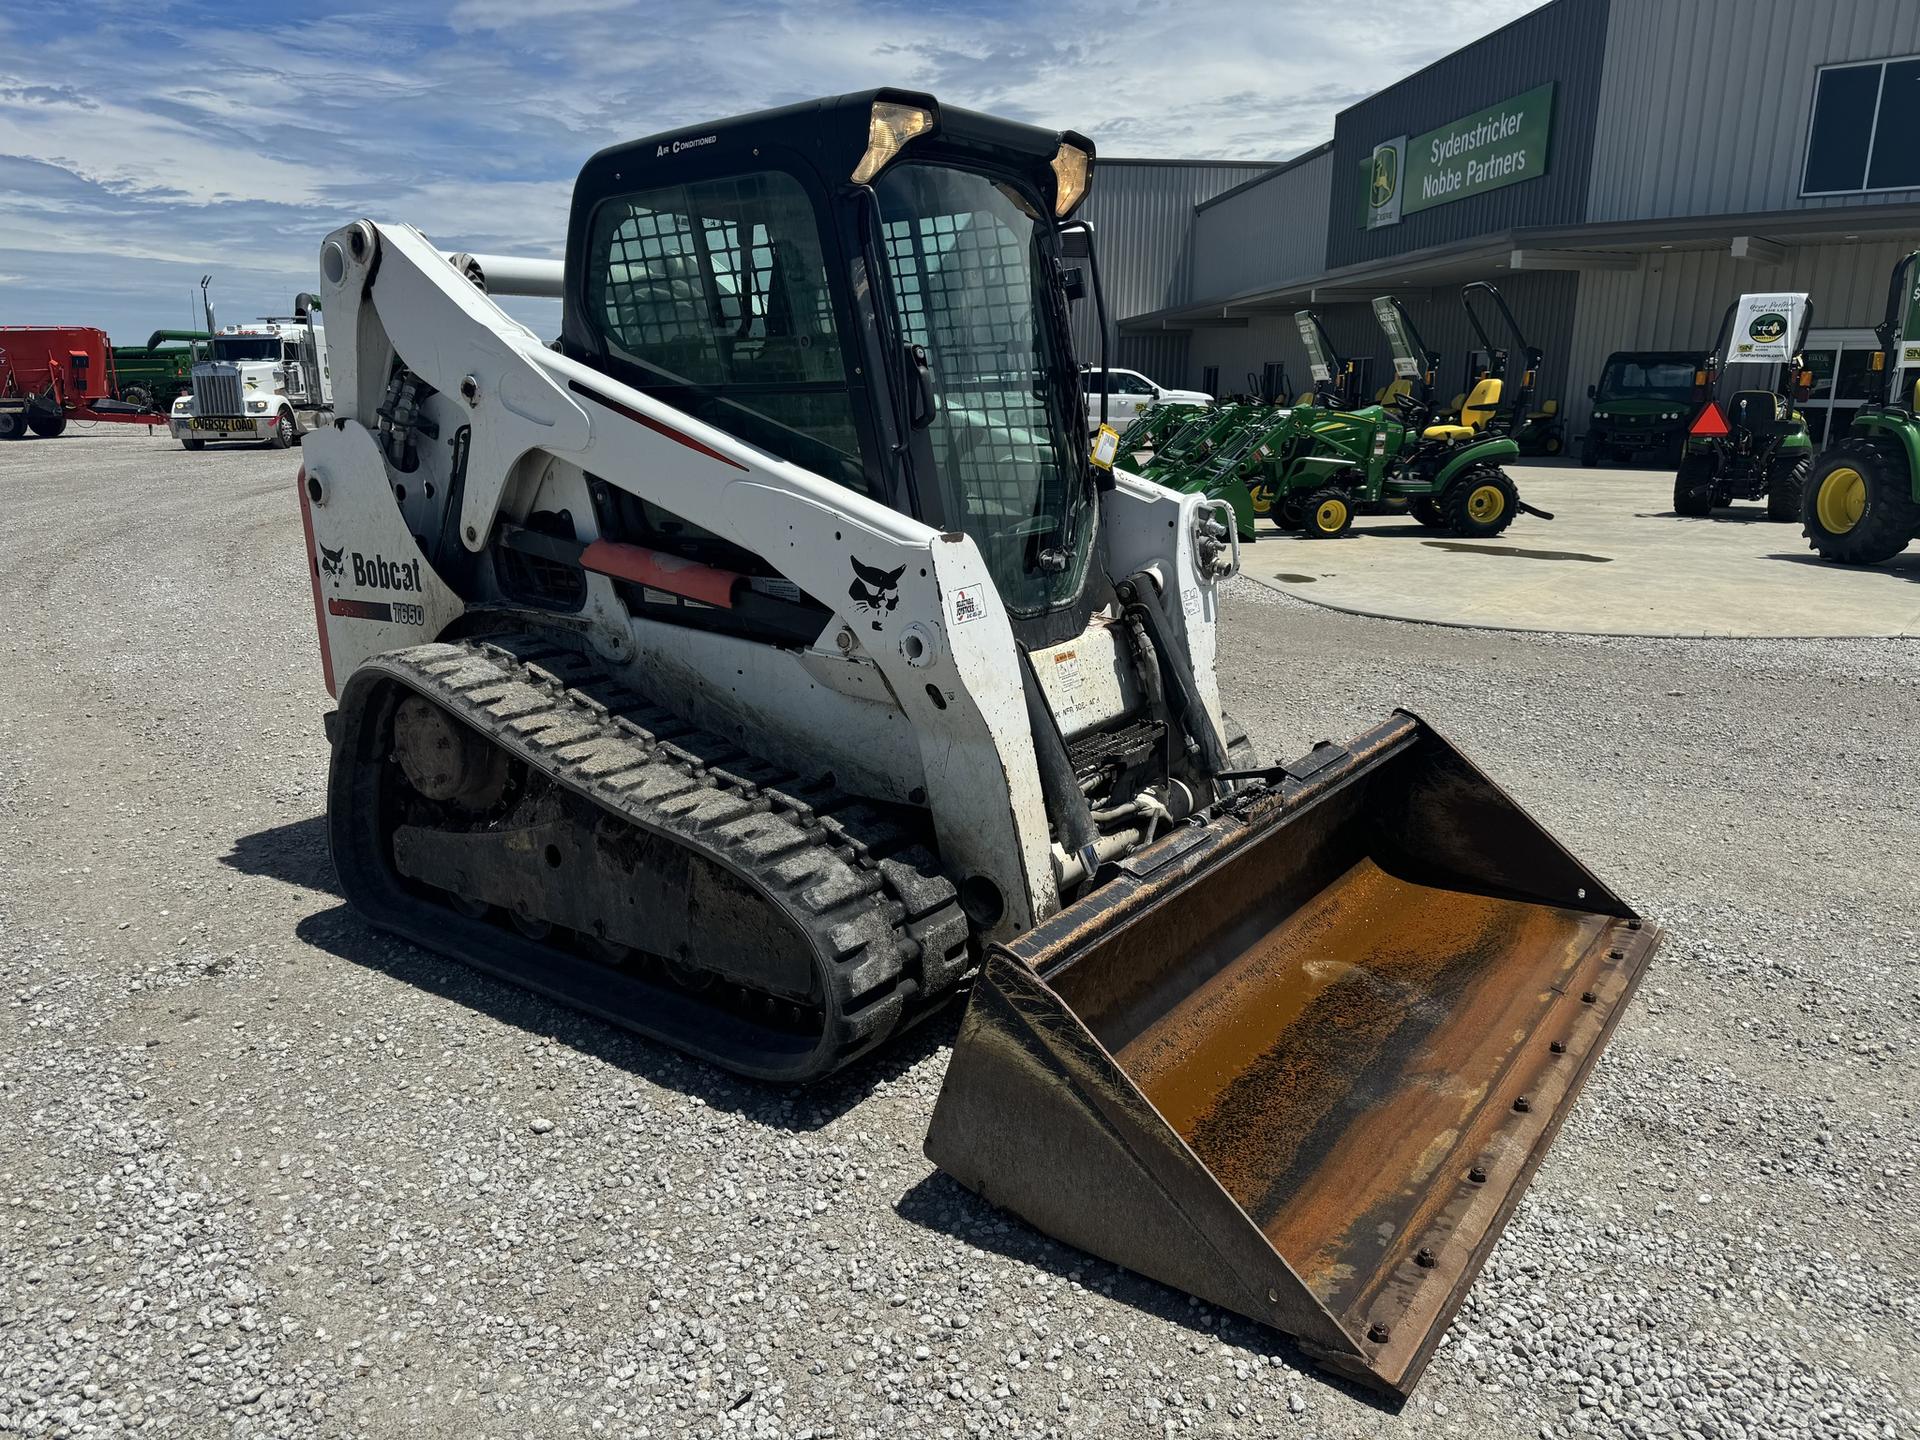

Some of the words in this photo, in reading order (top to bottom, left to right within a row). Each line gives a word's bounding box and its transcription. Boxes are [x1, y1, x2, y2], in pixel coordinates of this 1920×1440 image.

[1430, 111, 1523, 167] Sydenstricker
[1421, 167, 1462, 200] Nobbe
[1466, 149, 1526, 187] Partners
[193, 418, 231, 431] OVERSIZE
[233, 418, 254, 431] LOAD
[351, 552, 423, 592] Bobcat
[392, 602, 425, 626] T650
